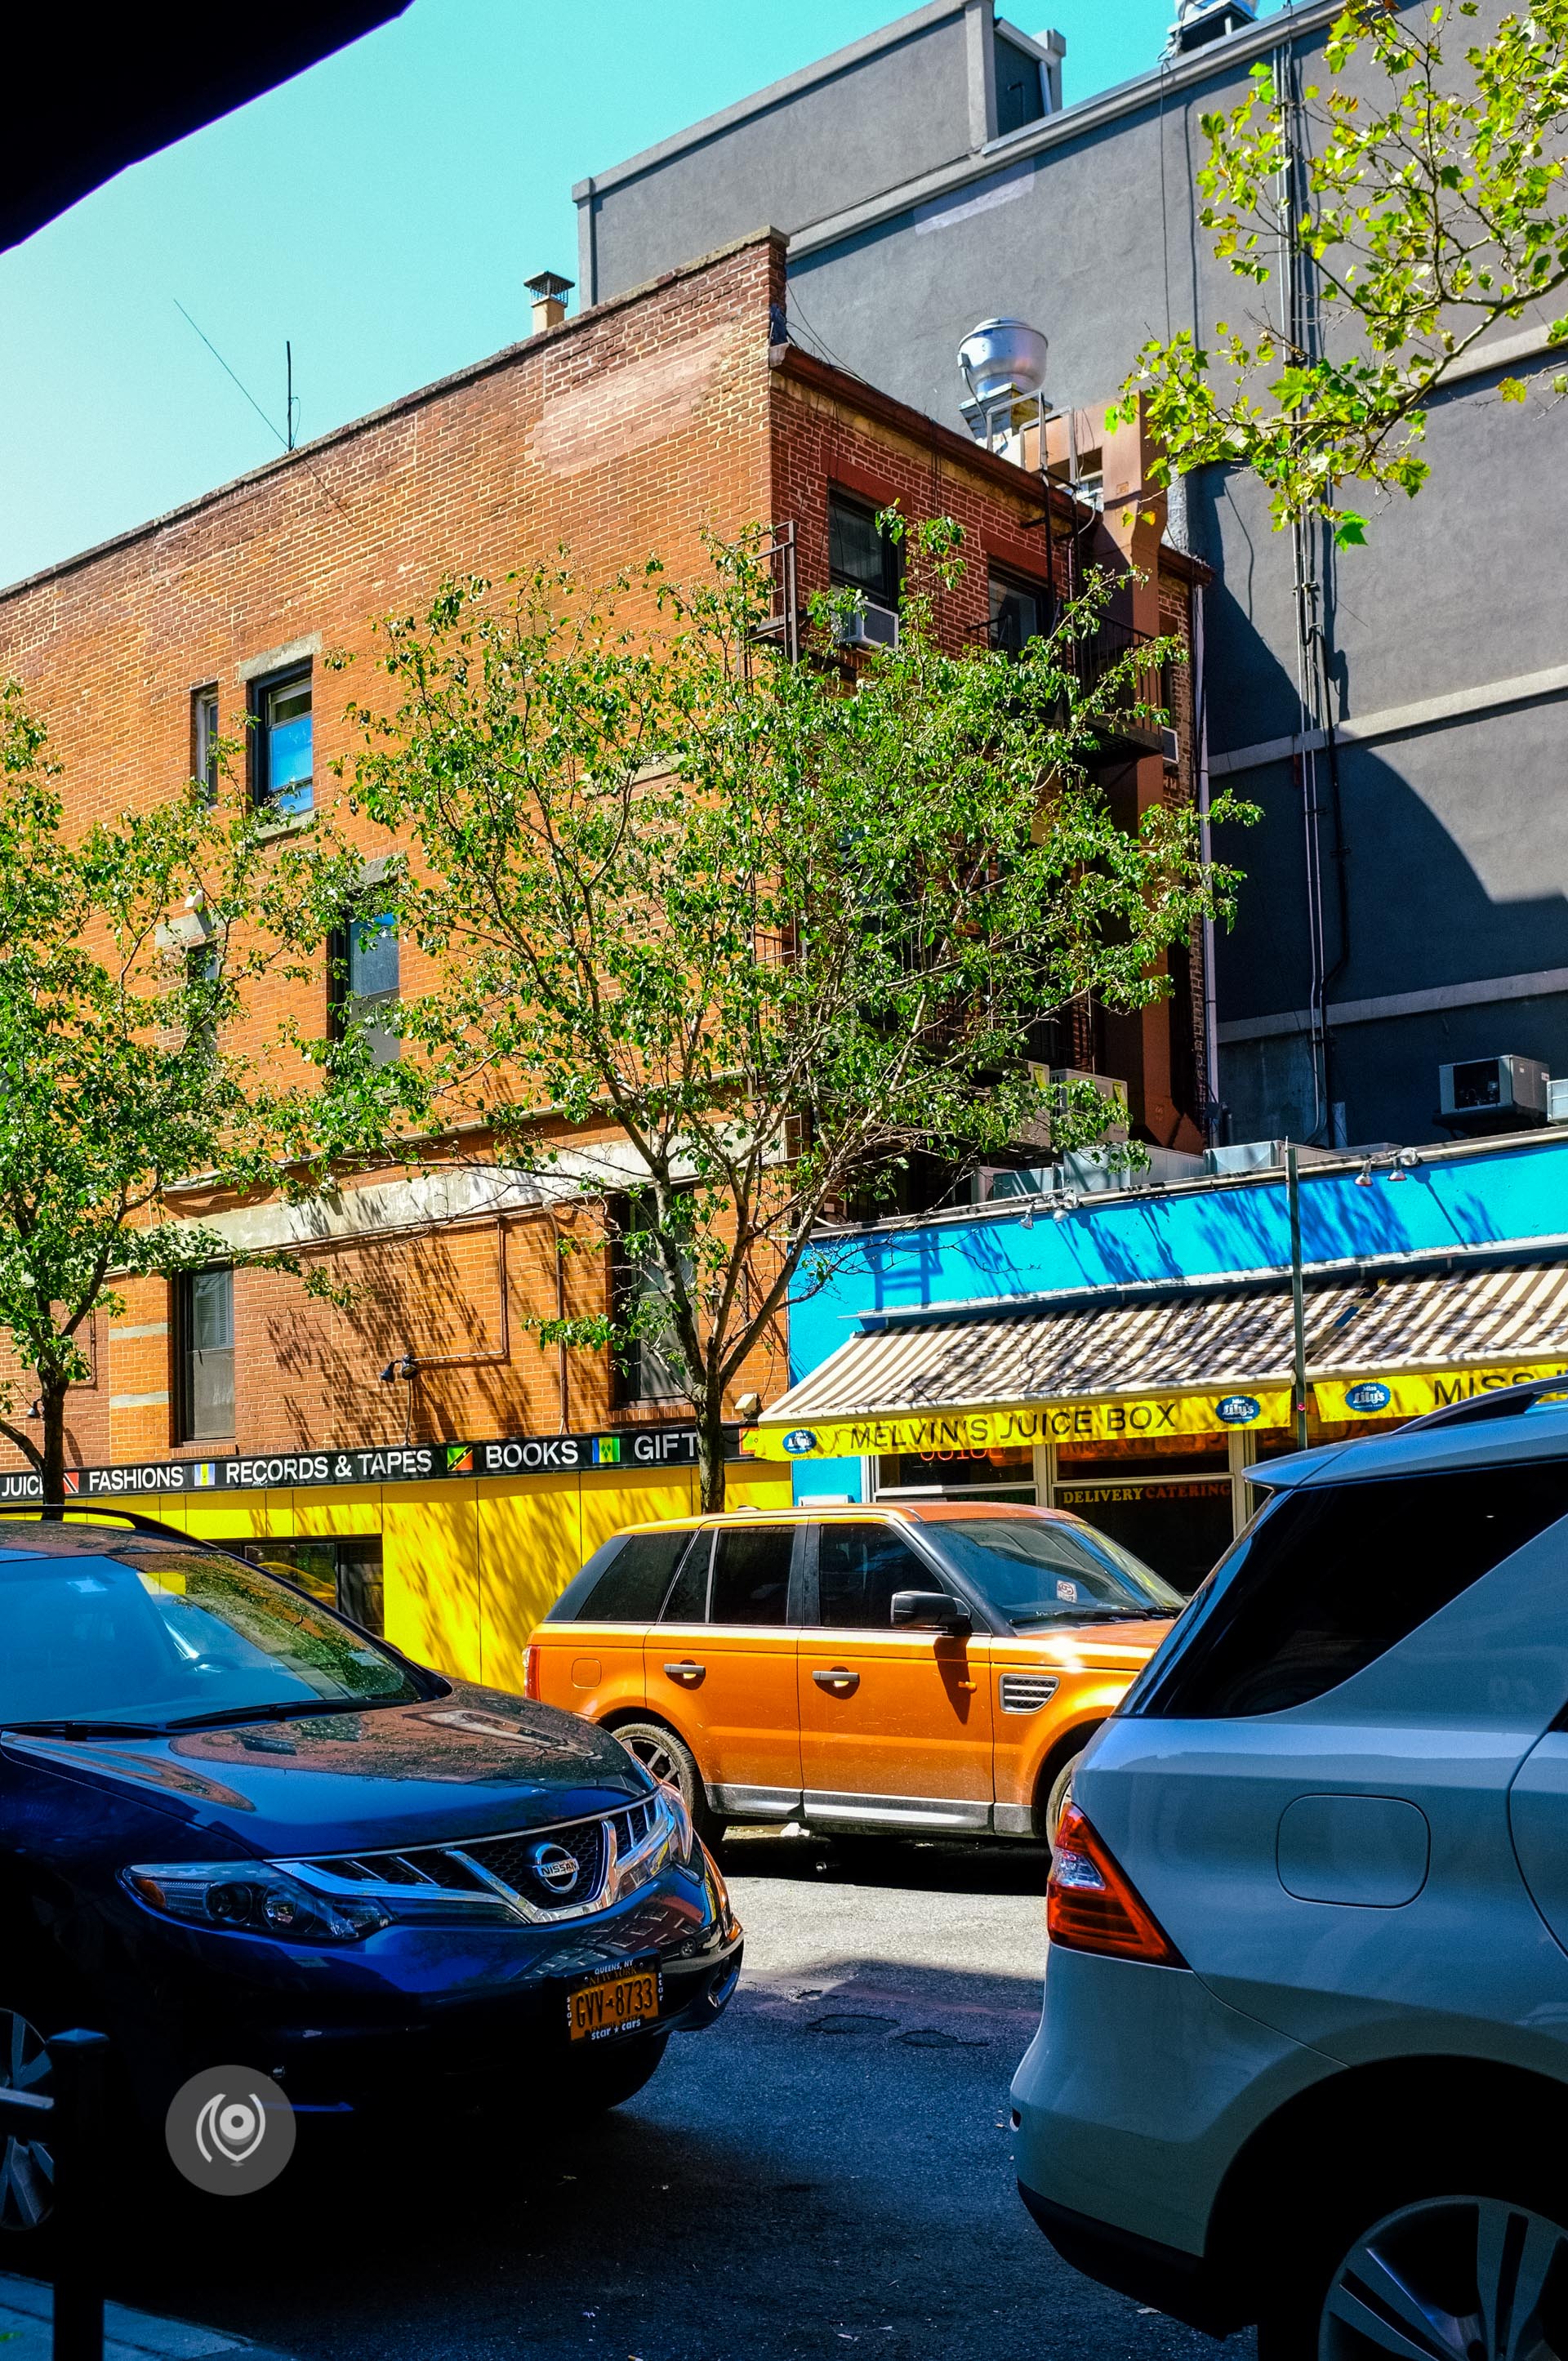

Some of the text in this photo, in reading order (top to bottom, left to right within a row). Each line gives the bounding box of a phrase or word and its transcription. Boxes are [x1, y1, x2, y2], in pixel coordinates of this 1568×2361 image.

[1353, 1390, 1385, 1404] Lily's
[1223, 1403, 1254, 1417] Lily's
[850, 1404, 1176, 1449] MELVIN'S JUICE BOX
[2, 1475, 44, 1496] JUIC
[89, 1466, 184, 1491] FASHIONS
[226, 1456, 328, 1484] RECORDS
[335, 1455, 352, 1477] &
[358, 1450, 432, 1477] TAPES
[486, 1439, 579, 1468] BOOKS
[1063, 1483, 1232, 1503] DELIVERY CATERING
[541, 1862, 577, 1875] NISSAN
[595, 1960, 634, 1975] QUEENS, NY
[591, 2028, 612, 2040] star
[621, 2019, 641, 2031] cars
